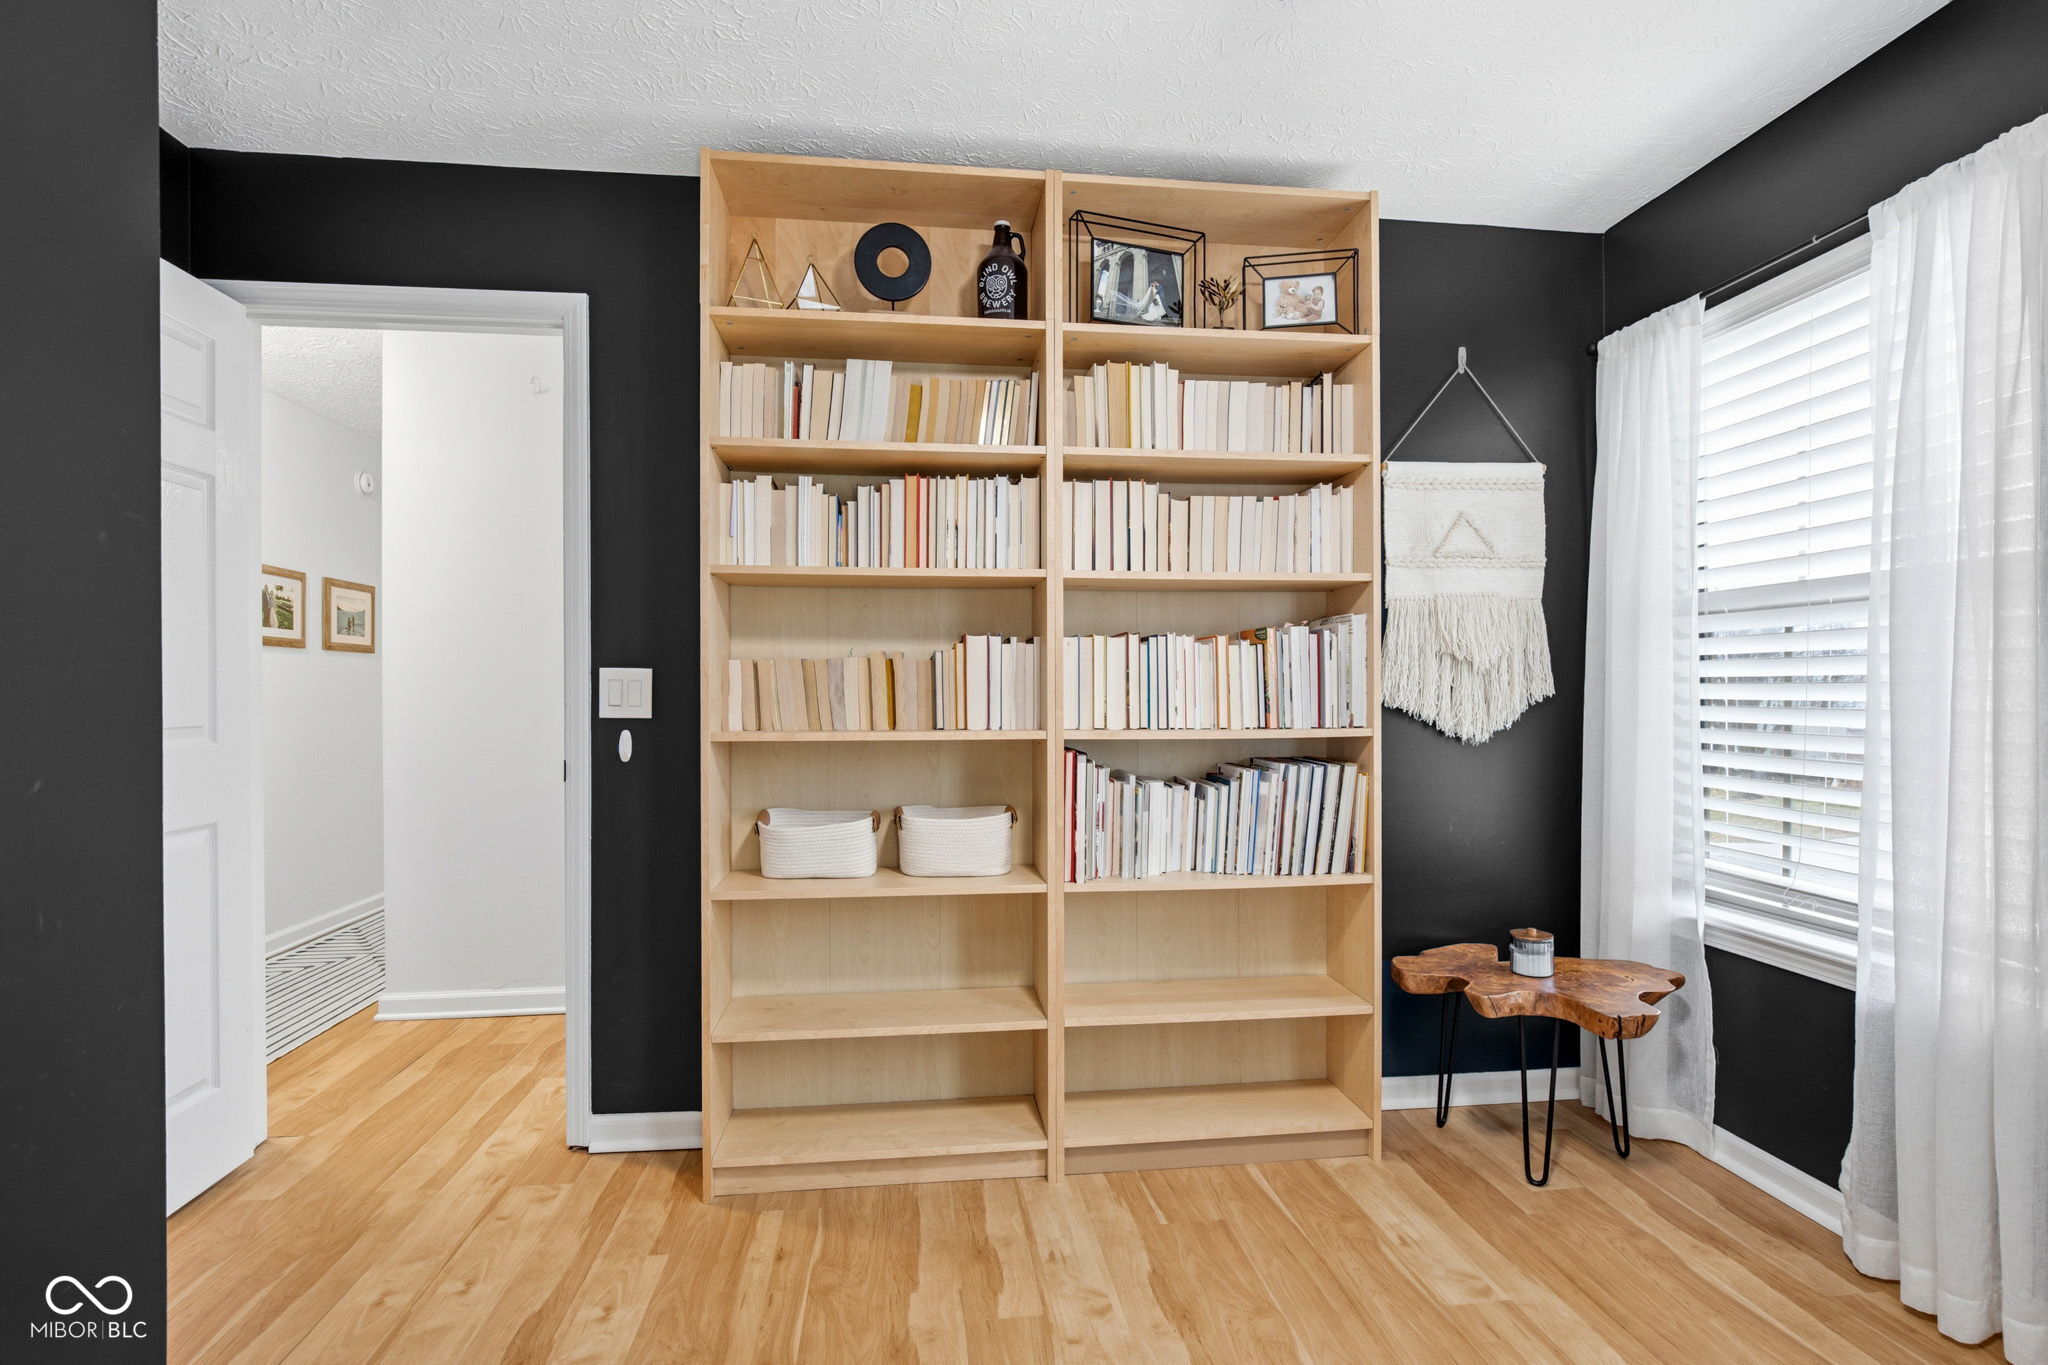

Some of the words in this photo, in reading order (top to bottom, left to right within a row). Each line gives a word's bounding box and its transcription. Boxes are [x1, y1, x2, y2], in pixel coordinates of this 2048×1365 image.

[979, 263, 998, 287] BLIND
[1001, 265, 1017, 285] OWL
[979, 289, 1016, 308] BREWERY
